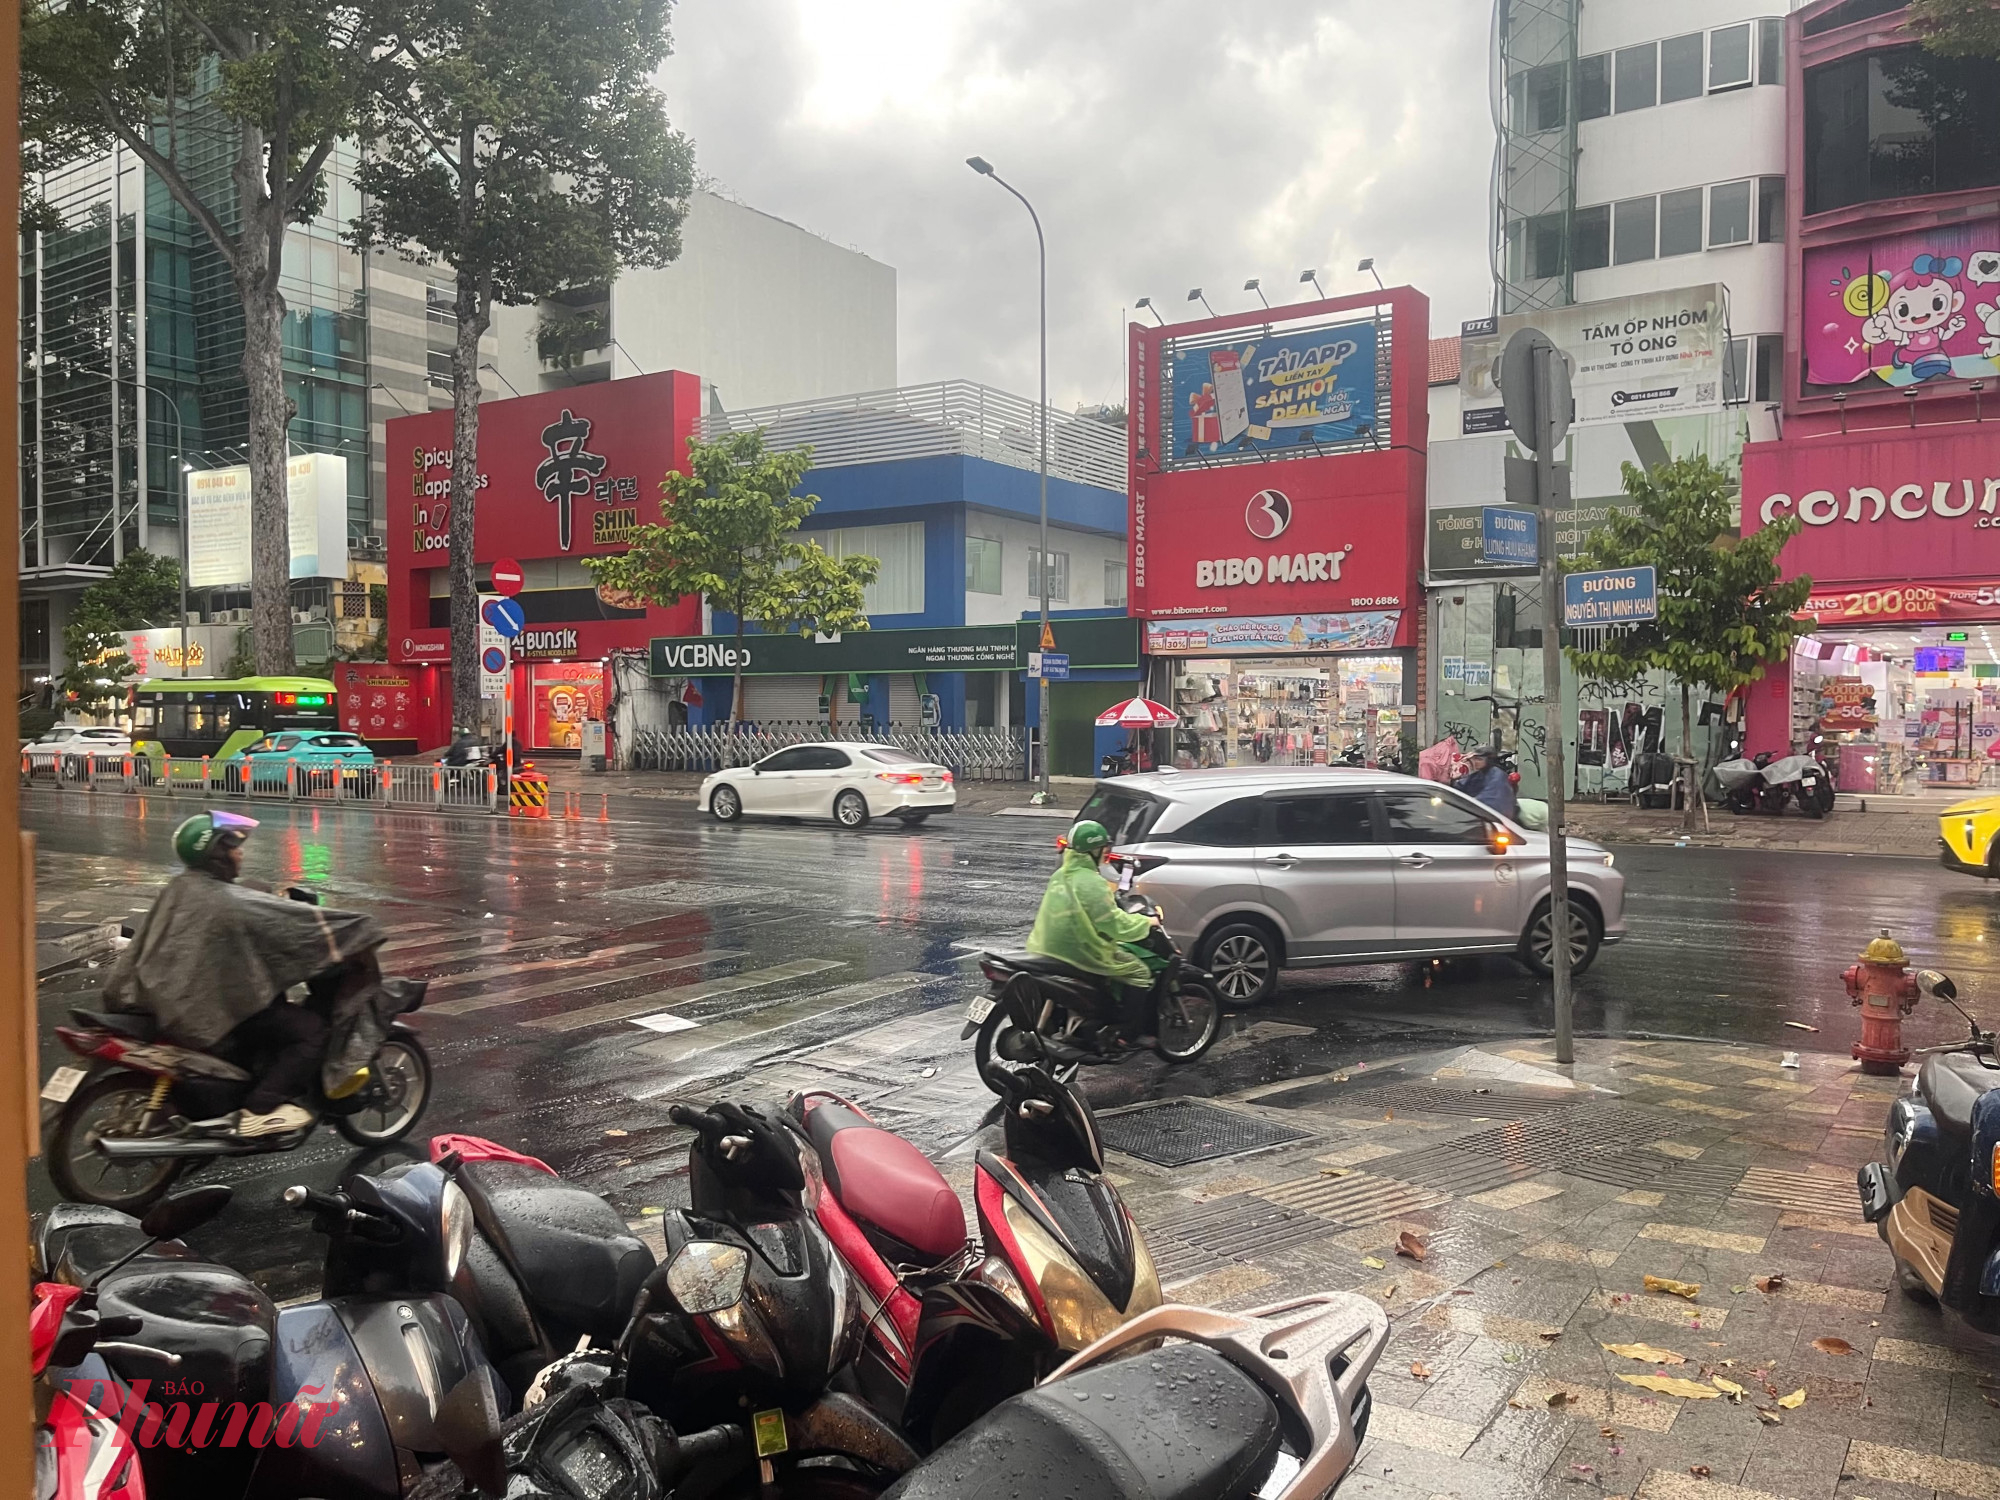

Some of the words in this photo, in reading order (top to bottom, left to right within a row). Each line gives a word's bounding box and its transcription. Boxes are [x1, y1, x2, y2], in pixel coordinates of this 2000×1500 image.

[1582, 322, 1620, 341] TẤM
[1623, 317, 1648, 335] ỐP
[1651, 309, 1709, 331] NHÔM
[1638, 335, 1677, 352] ONG
[1260, 349, 1300, 379] TẢI
[1301, 342, 1352, 369] APP
[1306, 367, 1324, 378] TAY
[1255, 388, 1294, 409] SĂN
[1297, 374, 1337, 401] HOT
[1272, 400, 1321, 421] DEAL
[1322, 403, 1352, 416] NGÀY
[413, 446, 454, 472] Spicy
[413, 473, 488, 500] Happss
[535, 408, 606, 550] 辛
[594, 475, 639, 505] 라면
[413, 503, 428, 526] In
[593, 508, 637, 531] SHIN
[1135, 491, 1145, 540] MART
[1494, 515, 1527, 532] ĐƯỜNG
[1577, 507, 1609, 521] XÂY
[1135, 543, 1145, 587] BIBO
[1196, 557, 1264, 588] BIBO
[1267, 551, 1346, 584] MART
[1582, 576, 1636, 593] ĐƯỜNG
[1151, 605, 1228, 616] www.bibomart.com
[1350, 598, 1373, 607] 1800
[1375, 596, 1400, 606] 6886
[1598, 601, 1612, 620] THỊ
[1612, 599, 1634, 616] MINH
[1634, 597, 1654, 615] KHAI
[415, 643, 445, 652] NONGSHIM
